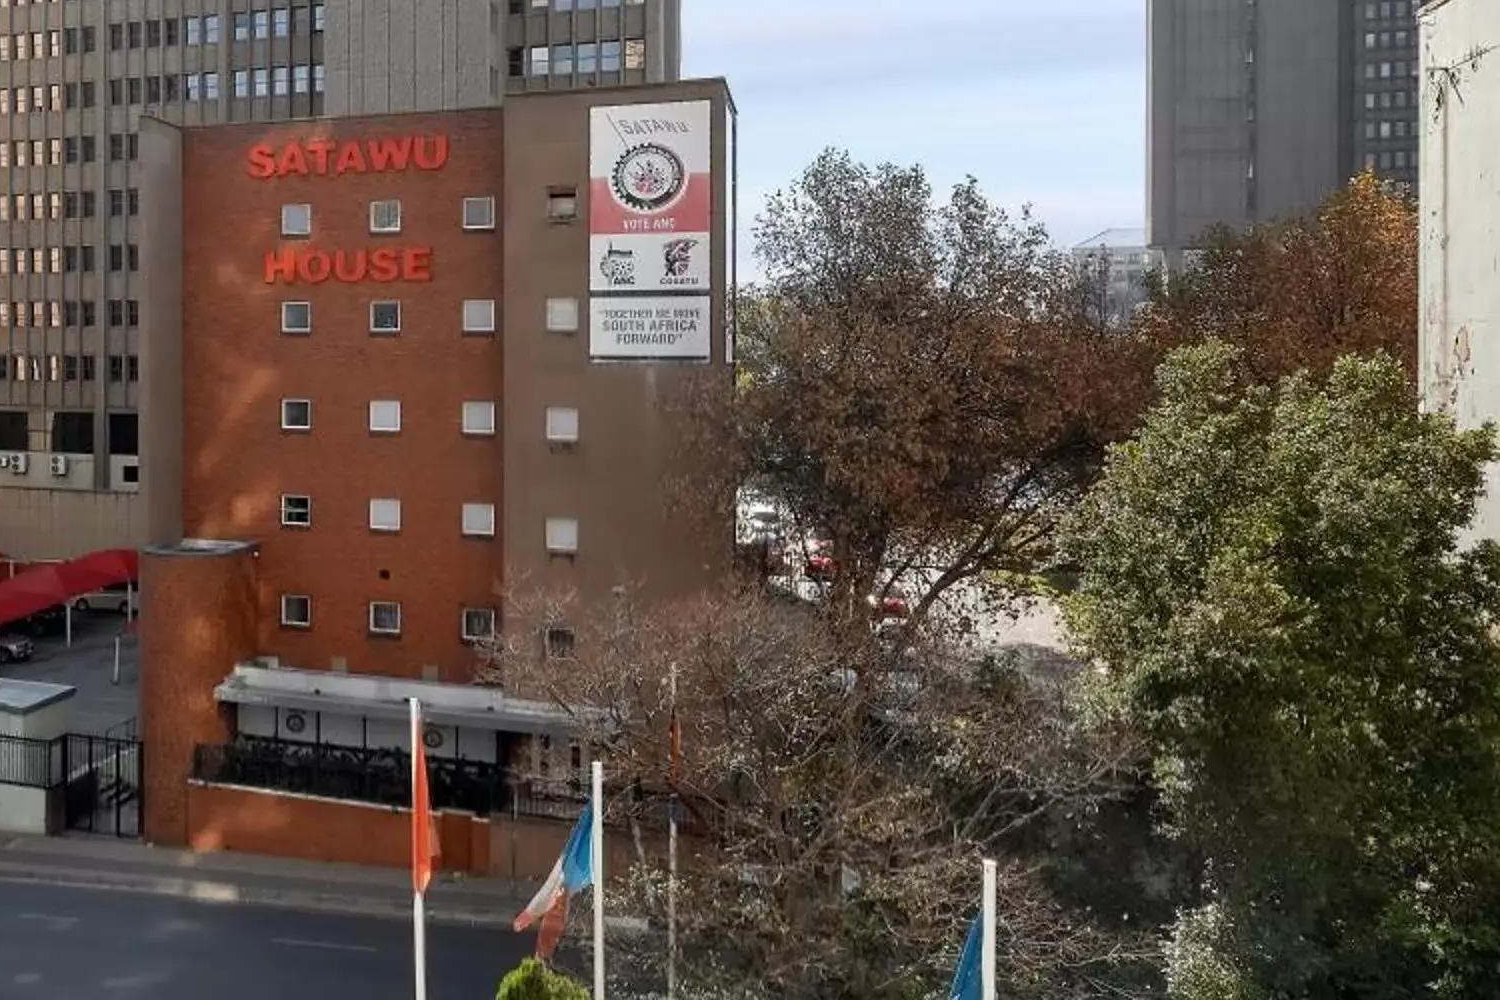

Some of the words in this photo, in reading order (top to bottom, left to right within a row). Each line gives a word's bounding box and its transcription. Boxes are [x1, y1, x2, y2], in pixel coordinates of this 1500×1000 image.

[248, 134, 450, 179] SATAWU
[623, 219, 650, 231] VOTE
[263, 246, 434, 284] HOUSE
[602, 320, 645, 331] SOUTH
[649, 320, 697, 332] AFRICA
